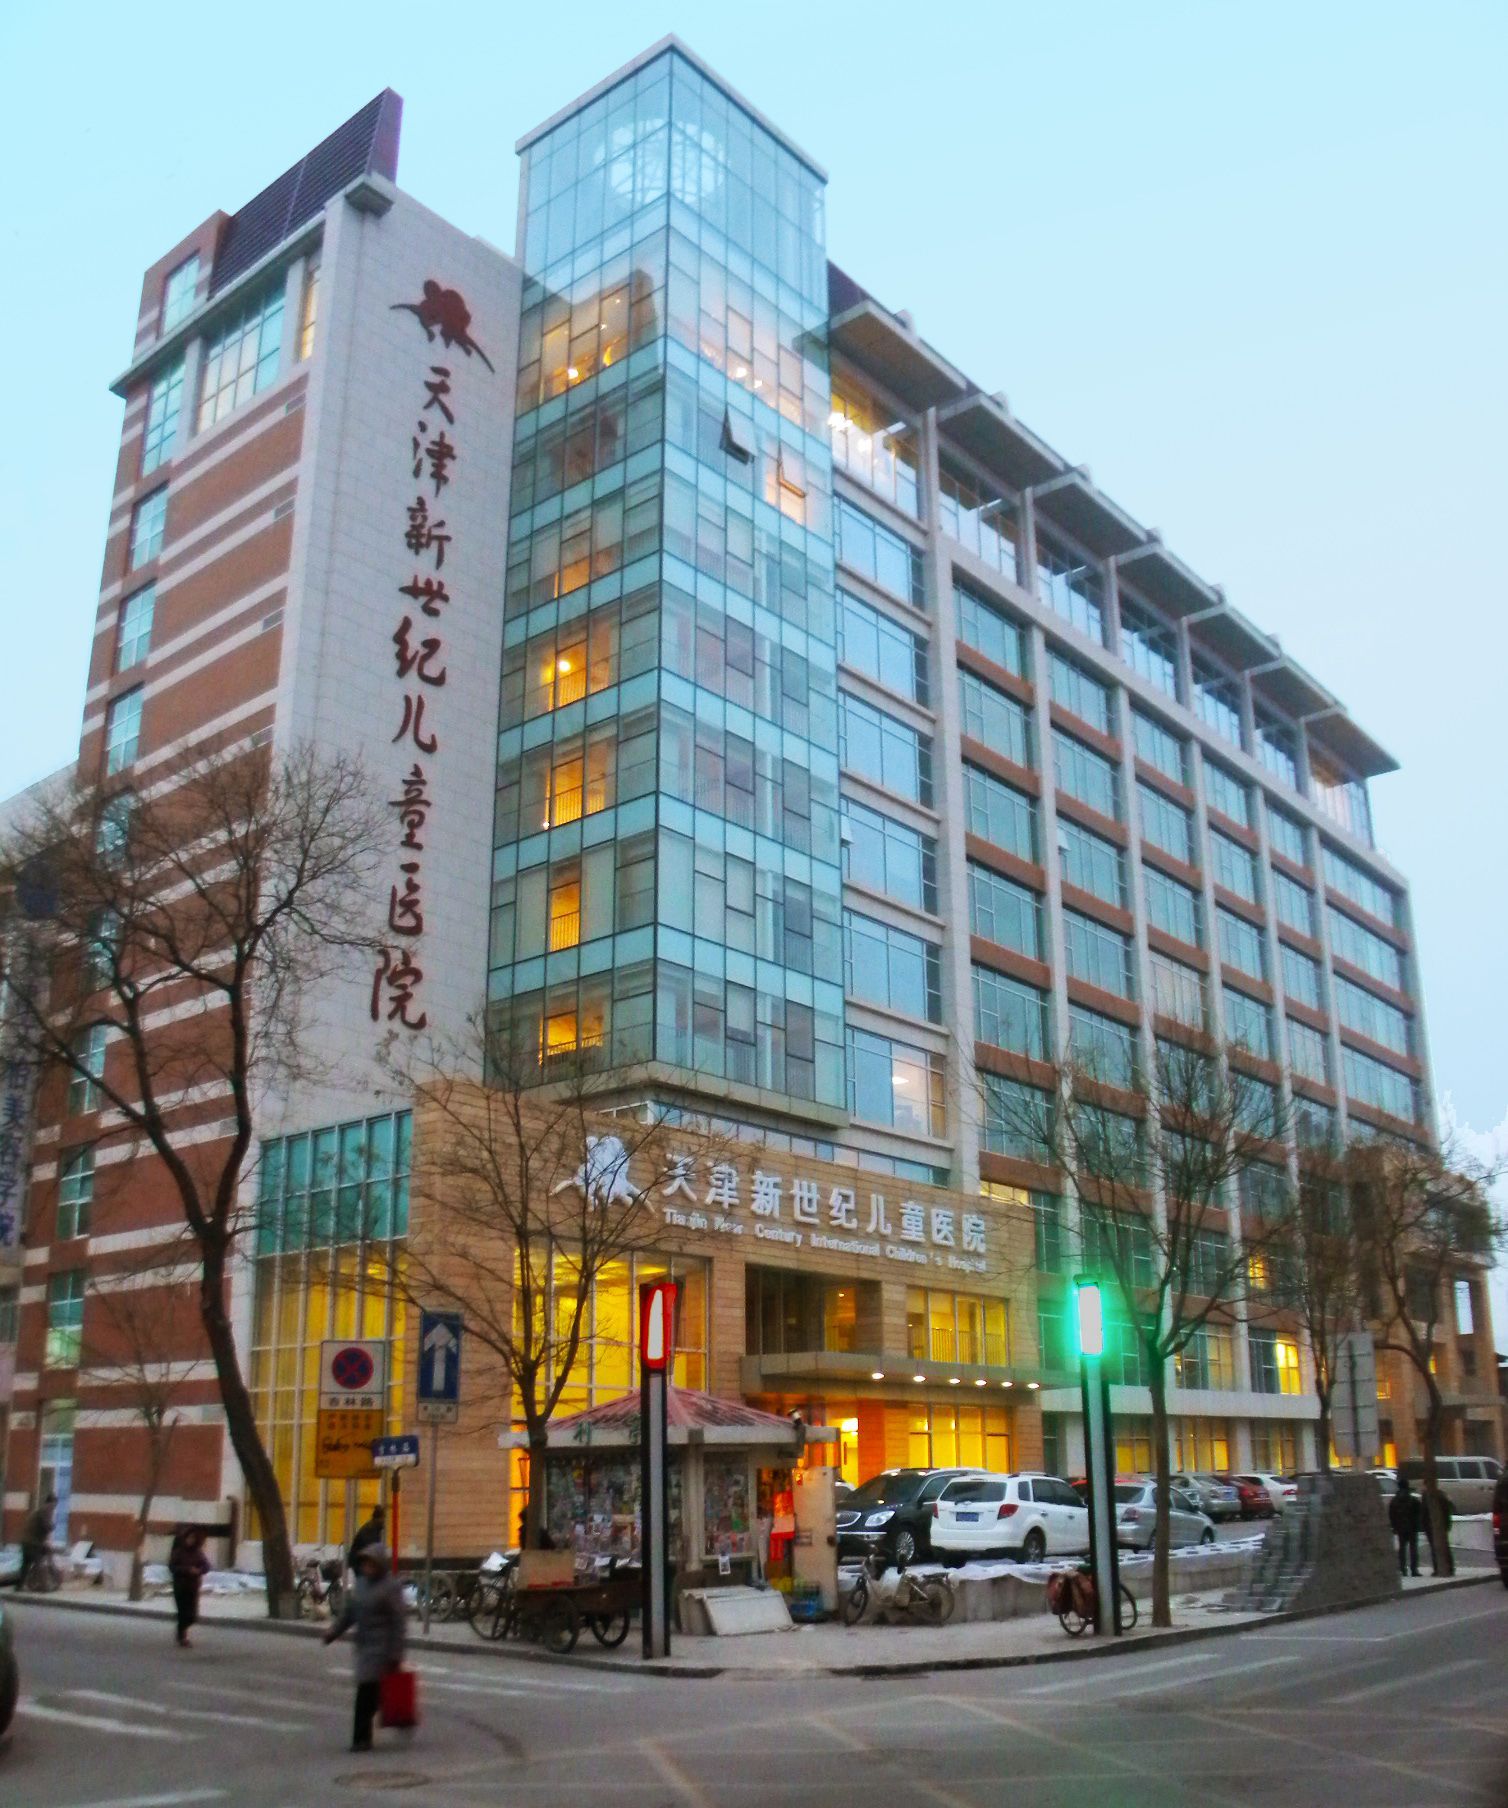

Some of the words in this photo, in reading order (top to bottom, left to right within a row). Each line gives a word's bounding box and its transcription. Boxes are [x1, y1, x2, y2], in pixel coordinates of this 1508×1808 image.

[371, 365, 457, 1032] 天津新世纪儿童医院
[661, 1153, 987, 1254] 天津新世纪儿童医院
[663, 1207, 708, 1230] Tianjin
[755, 1223, 803, 1248] Century
[810, 1233, 880, 1257] International
